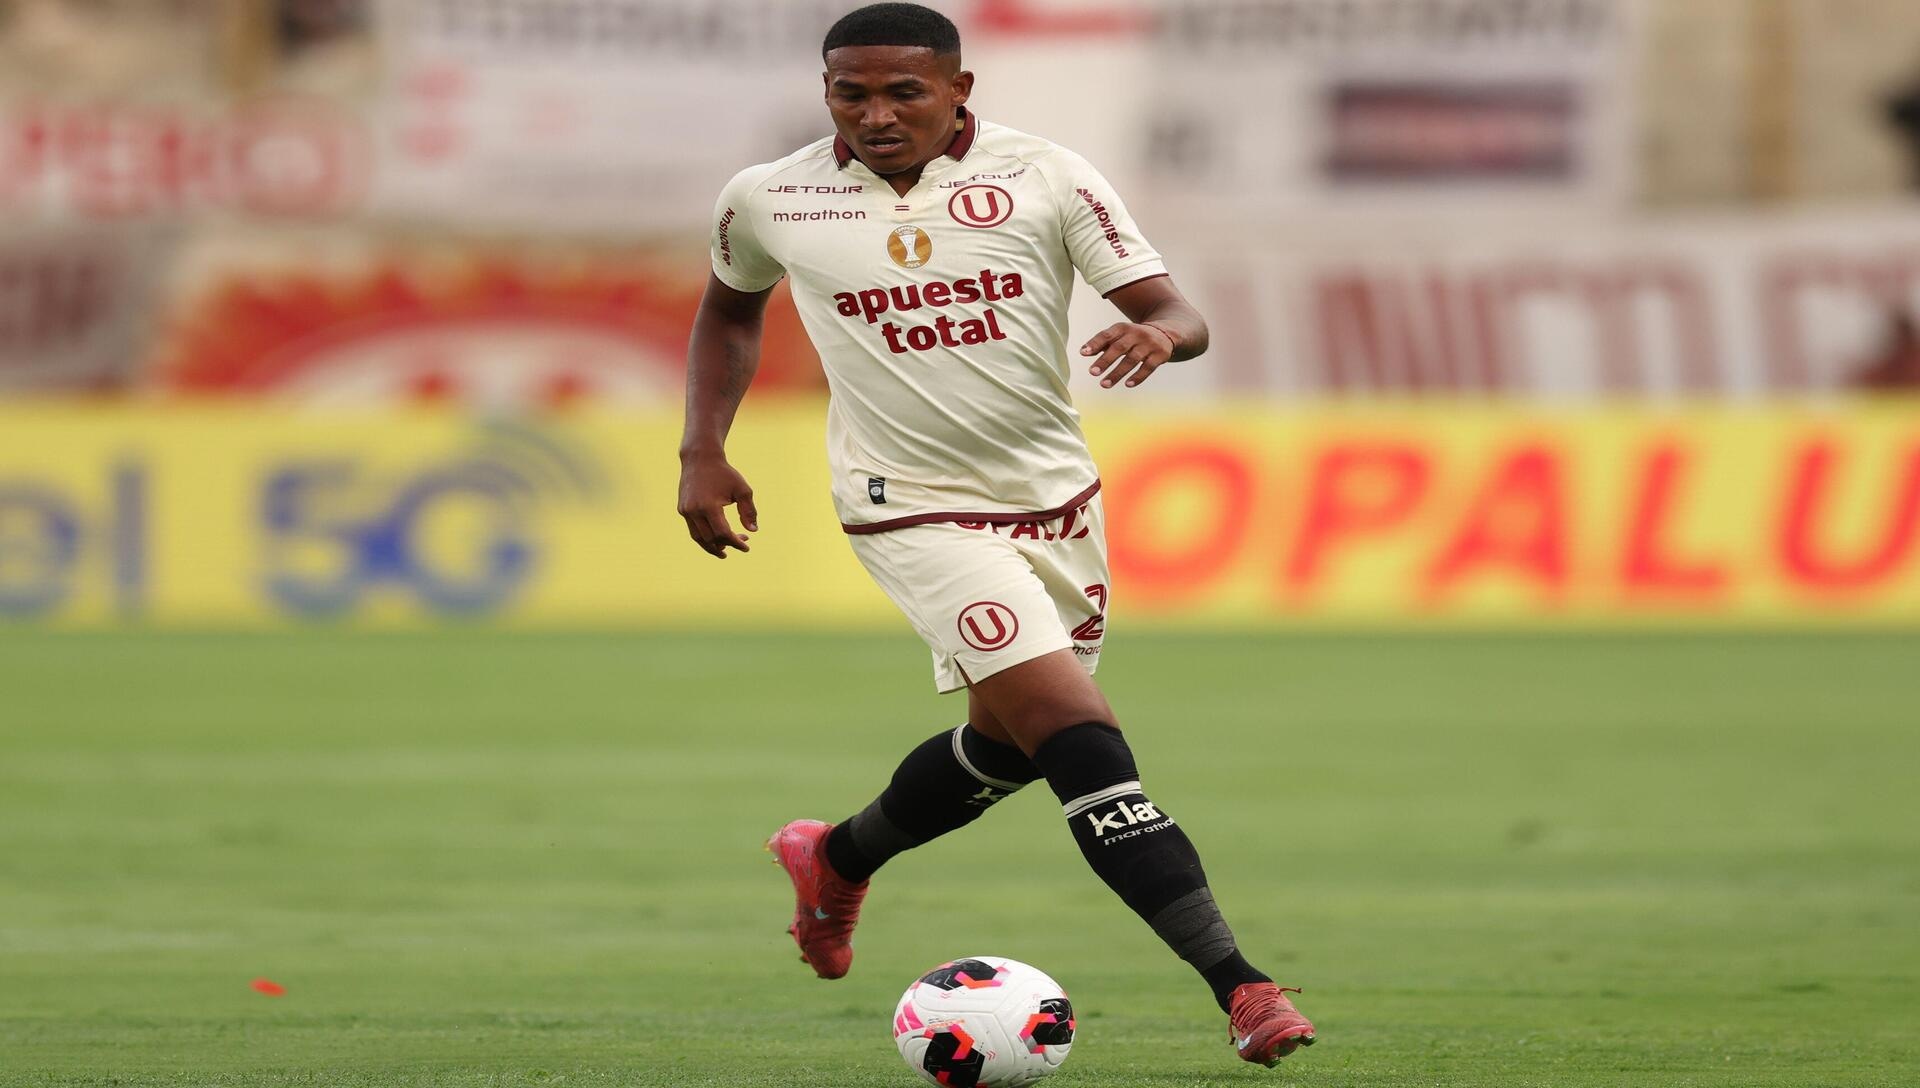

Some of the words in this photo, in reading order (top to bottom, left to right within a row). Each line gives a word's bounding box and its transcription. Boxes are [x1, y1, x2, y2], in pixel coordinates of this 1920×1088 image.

[767, 185, 863, 194] JETOUR
[939, 168, 1025, 188] JETOUR
[773, 209, 867, 222] marathon
[961, 191, 999, 222] U
[719, 207, 736, 253] MOVISUN
[1090, 201, 1129, 259] MOVISUN
[833, 268, 1025, 324] apuesta
[881, 308, 1007, 354] total
[260, 458, 545, 618] 5G
[965, 607, 1007, 645] U
